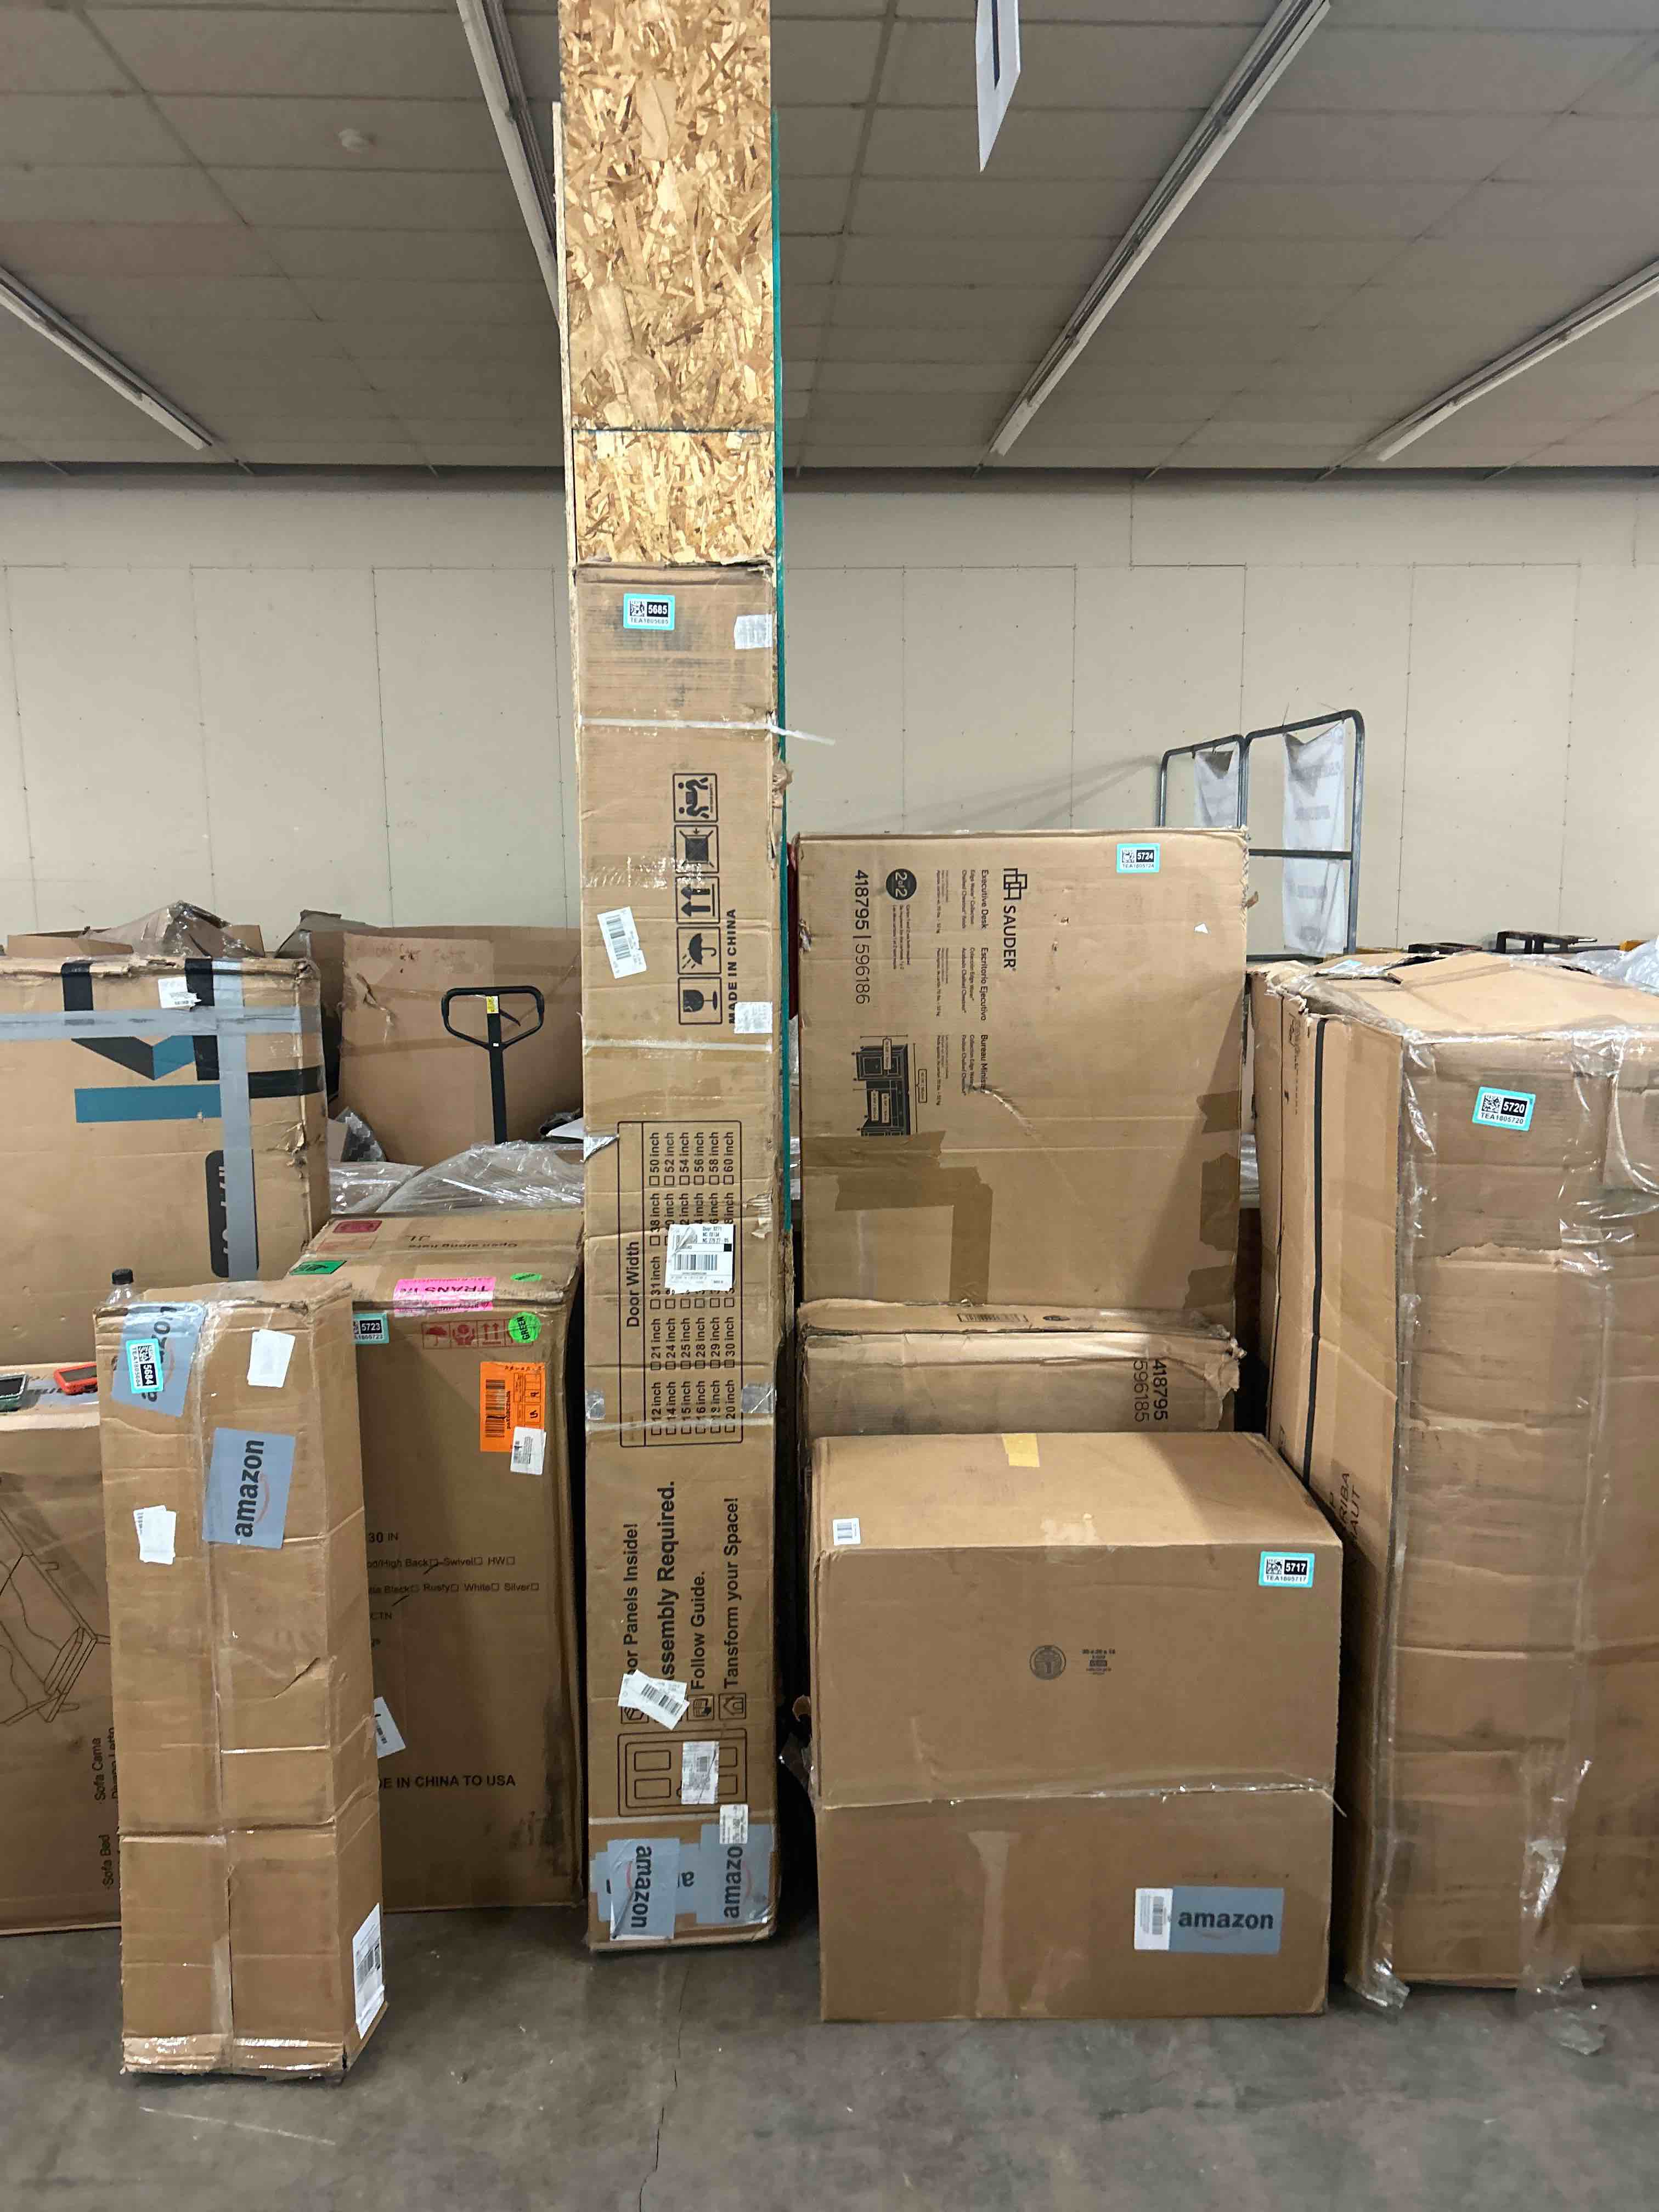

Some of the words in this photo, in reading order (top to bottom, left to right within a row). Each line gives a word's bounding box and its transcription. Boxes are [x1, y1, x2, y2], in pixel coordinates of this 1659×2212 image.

[648, 605, 667, 614] 5685
[1137, 852, 1153, 860] 5724
[855, 870, 869, 929] 418795
[726, 909, 736, 962] CHINA
[727, 966, 738, 979] IN
[855, 944, 869, 1004] 596186
[728, 982, 738, 1024] MADE
[1481, 1113, 1523, 1124] TEA1805720
[1503, 1102, 1525, 1114] 5720
[650, 1132, 659, 1156] inch
[664, 1132, 674, 1156] inch
[680, 1132, 689, 1156] inch
[694, 1132, 704, 1156] inch
[709, 1132, 719, 1156] inch
[724, 1132, 733, 1156] inch
[650, 1159, 659, 1172] 50
[664, 1159, 674, 1172] 52
[680, 1159, 689, 1172] 54
[694, 1159, 704, 1172] 56
[709, 1159, 719, 1172] 58
[724, 1159, 733, 1172] 60
[650, 1193, 660, 1217] inch
[664, 1193, 674, 1216] inch
[680, 1193, 689, 1216] inch
[694, 1193, 704, 1216] inch
[709, 1193, 719, 1216] inch
[724, 1193, 733, 1216] inch
[651, 1220, 660, 1232] 38
[627, 1241, 640, 1286] Width
[651, 1256, 660, 1280] inch
[425, 1284, 488, 1294] TRANS
[651, 1283, 660, 1295] 31
[627, 1289, 640, 1328] Door
[362, 1323, 381, 1331] 5723
[521, 1314, 531, 1340] GREEN
[651, 1318, 661, 1342] inch
[666, 1318, 676, 1342] inch
[681, 1318, 691, 1342] inch
[696, 1317, 706, 1341] inch
[710, 1317, 720, 1341] inch
[725, 1317, 735, 1340] inch
[651, 1346, 661, 1359] 21
[666, 1345, 676, 1358] 24
[681, 1345, 691, 1358] 25
[696, 1344, 706, 1357] 28
[710, 1344, 720, 1357] 29
[725, 1343, 735, 1357] 30
[143, 1364, 155, 1385] 5684
[651, 1382, 661, 1406] inch
[666, 1381, 676, 1406] inch
[681, 1381, 691, 1406] inch
[696, 1381, 706, 1405] inch
[710, 1380, 720, 1404] inch
[725, 1380, 735, 1404] inch
[1133, 1361, 1149, 1423] 596185
[1153, 1359, 1169, 1421] 418795
[651, 1408, 661, 1421] 12
[666, 1408, 676, 1420] 14
[681, 1407, 691, 1420] 15
[725, 1406, 735, 1419] 20
[235, 1439, 264, 1538] amazon
[657, 1481, 678, 1581] Required.
[724, 1497, 742, 1556] Space!
[405, 1558, 430, 1567] Back
[443, 1556, 474, 1565] Swivel
[624, 1523, 639, 1581] Inside!
[1286, 1562, 1306, 1572] 5717
[463, 1583, 492, 1592] White
[504, 1583, 531, 1592] Silver
[727, 1561, 742, 1600] your
[691, 1571, 706, 1628] Guide.
[624, 1586, 639, 1645] Panels
[658, 1589, 679, 1681] ssembly
[724, 1605, 738, 1689] Tansform
[691, 1633, 706, 1690] Follow
[92, 1737, 104, 1771] Cama
[397, 1777, 410, 1787] IN
[415, 1776, 459, 1787] CHINA
[463, 1775, 483, 1786] TO
[487, 1775, 516, 1786] USA
[99, 1835, 111, 1856] Bed
[631, 1845, 652, 1928] amazon
[724, 1846, 743, 1918] amazo
[1177, 1911, 1274, 1930] amazon
